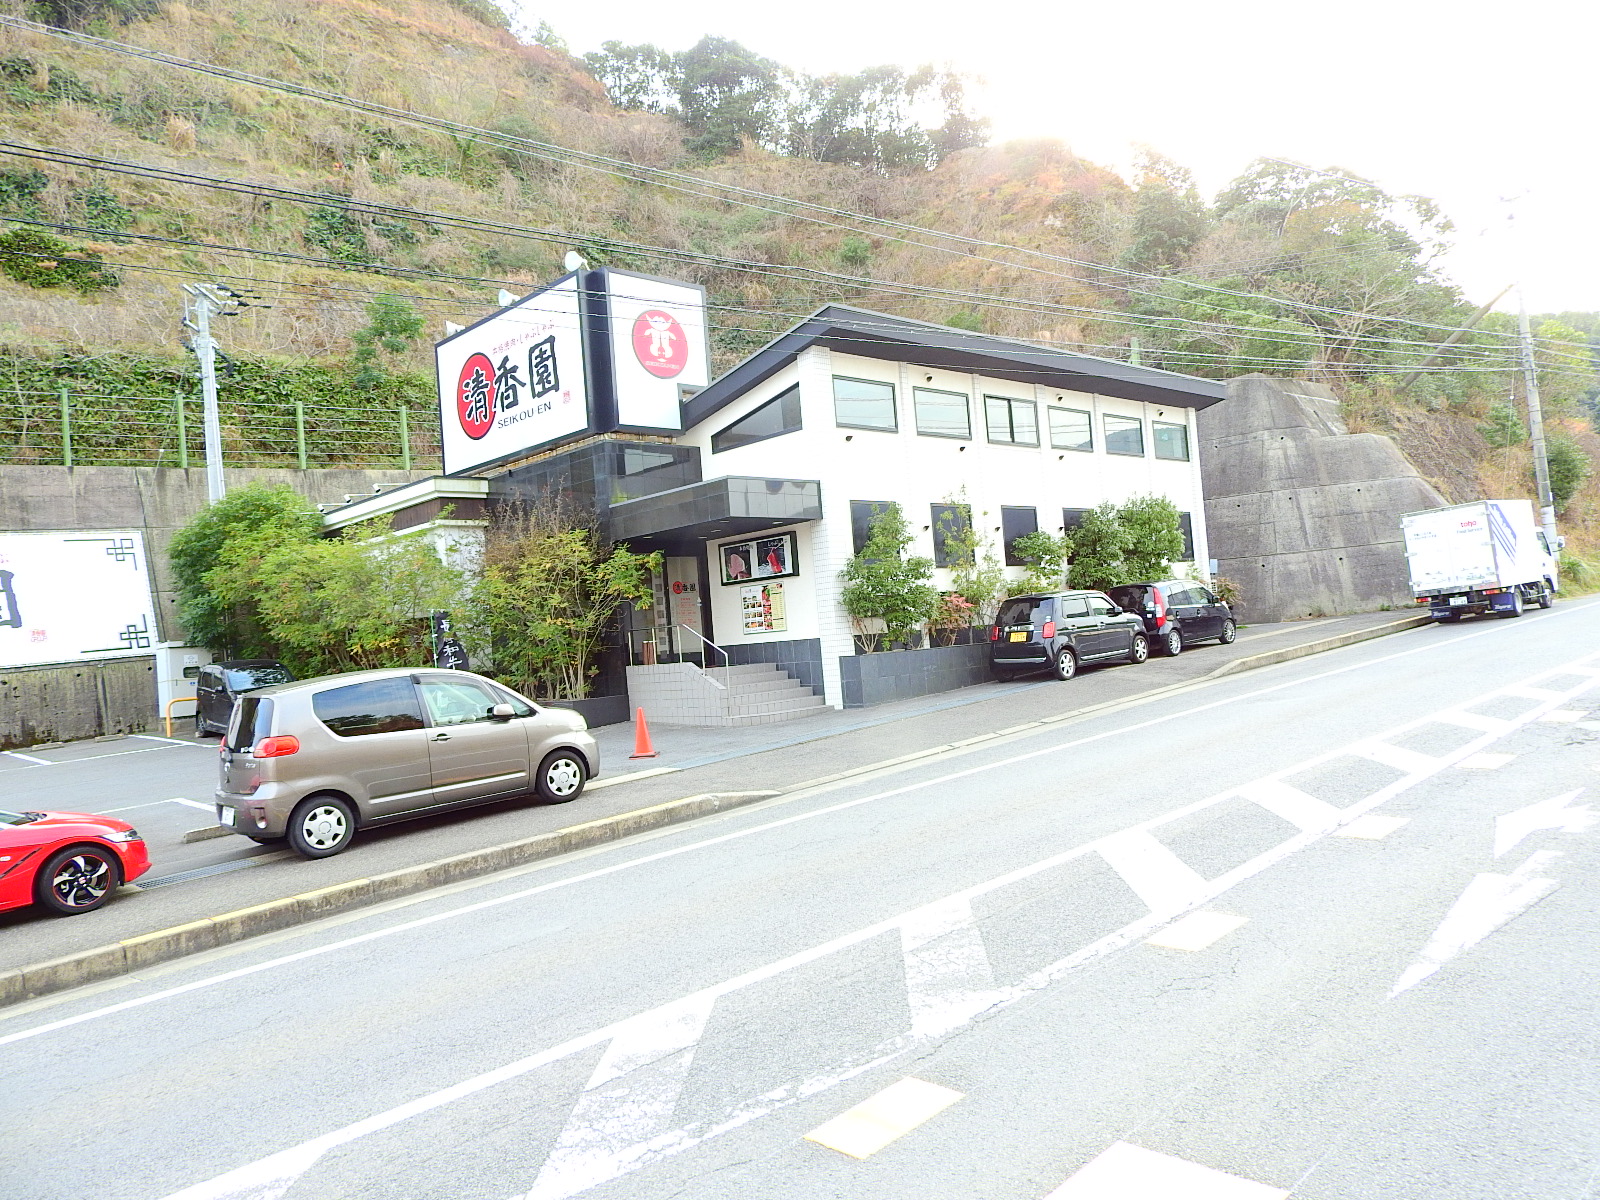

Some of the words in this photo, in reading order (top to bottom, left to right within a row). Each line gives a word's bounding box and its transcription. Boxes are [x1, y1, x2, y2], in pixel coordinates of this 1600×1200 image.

[462, 334, 560, 424] 清香園
[497, 407, 534, 429] SEIKOU
[537, 401, 552, 414] EN
